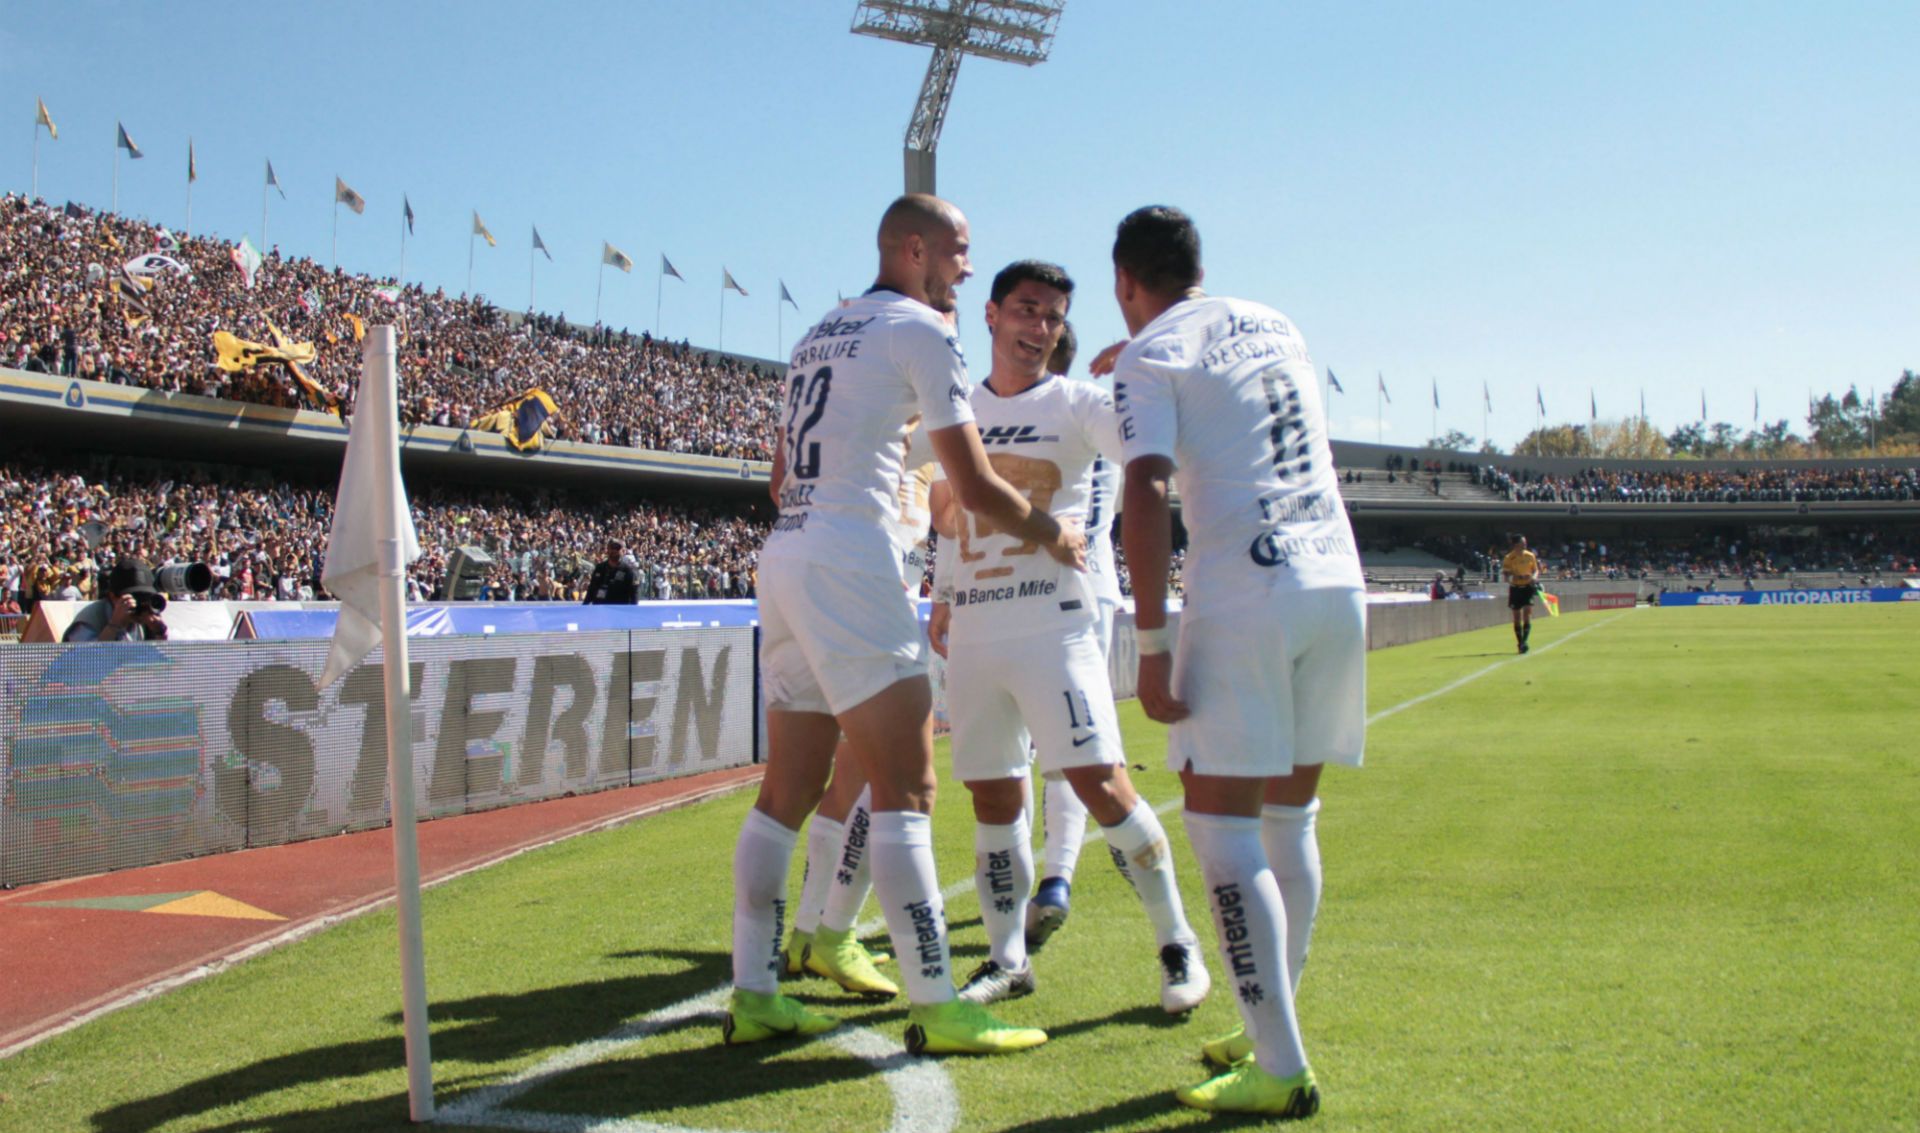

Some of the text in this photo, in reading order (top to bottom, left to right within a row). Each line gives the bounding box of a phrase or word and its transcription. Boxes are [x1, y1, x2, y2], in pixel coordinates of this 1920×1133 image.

[968, 586, 1014, 604] Banca
[1760, 590, 1872, 605] AUTOPARTES
[1063, 690, 1094, 728] 11
[214, 645, 731, 827] STEREN
